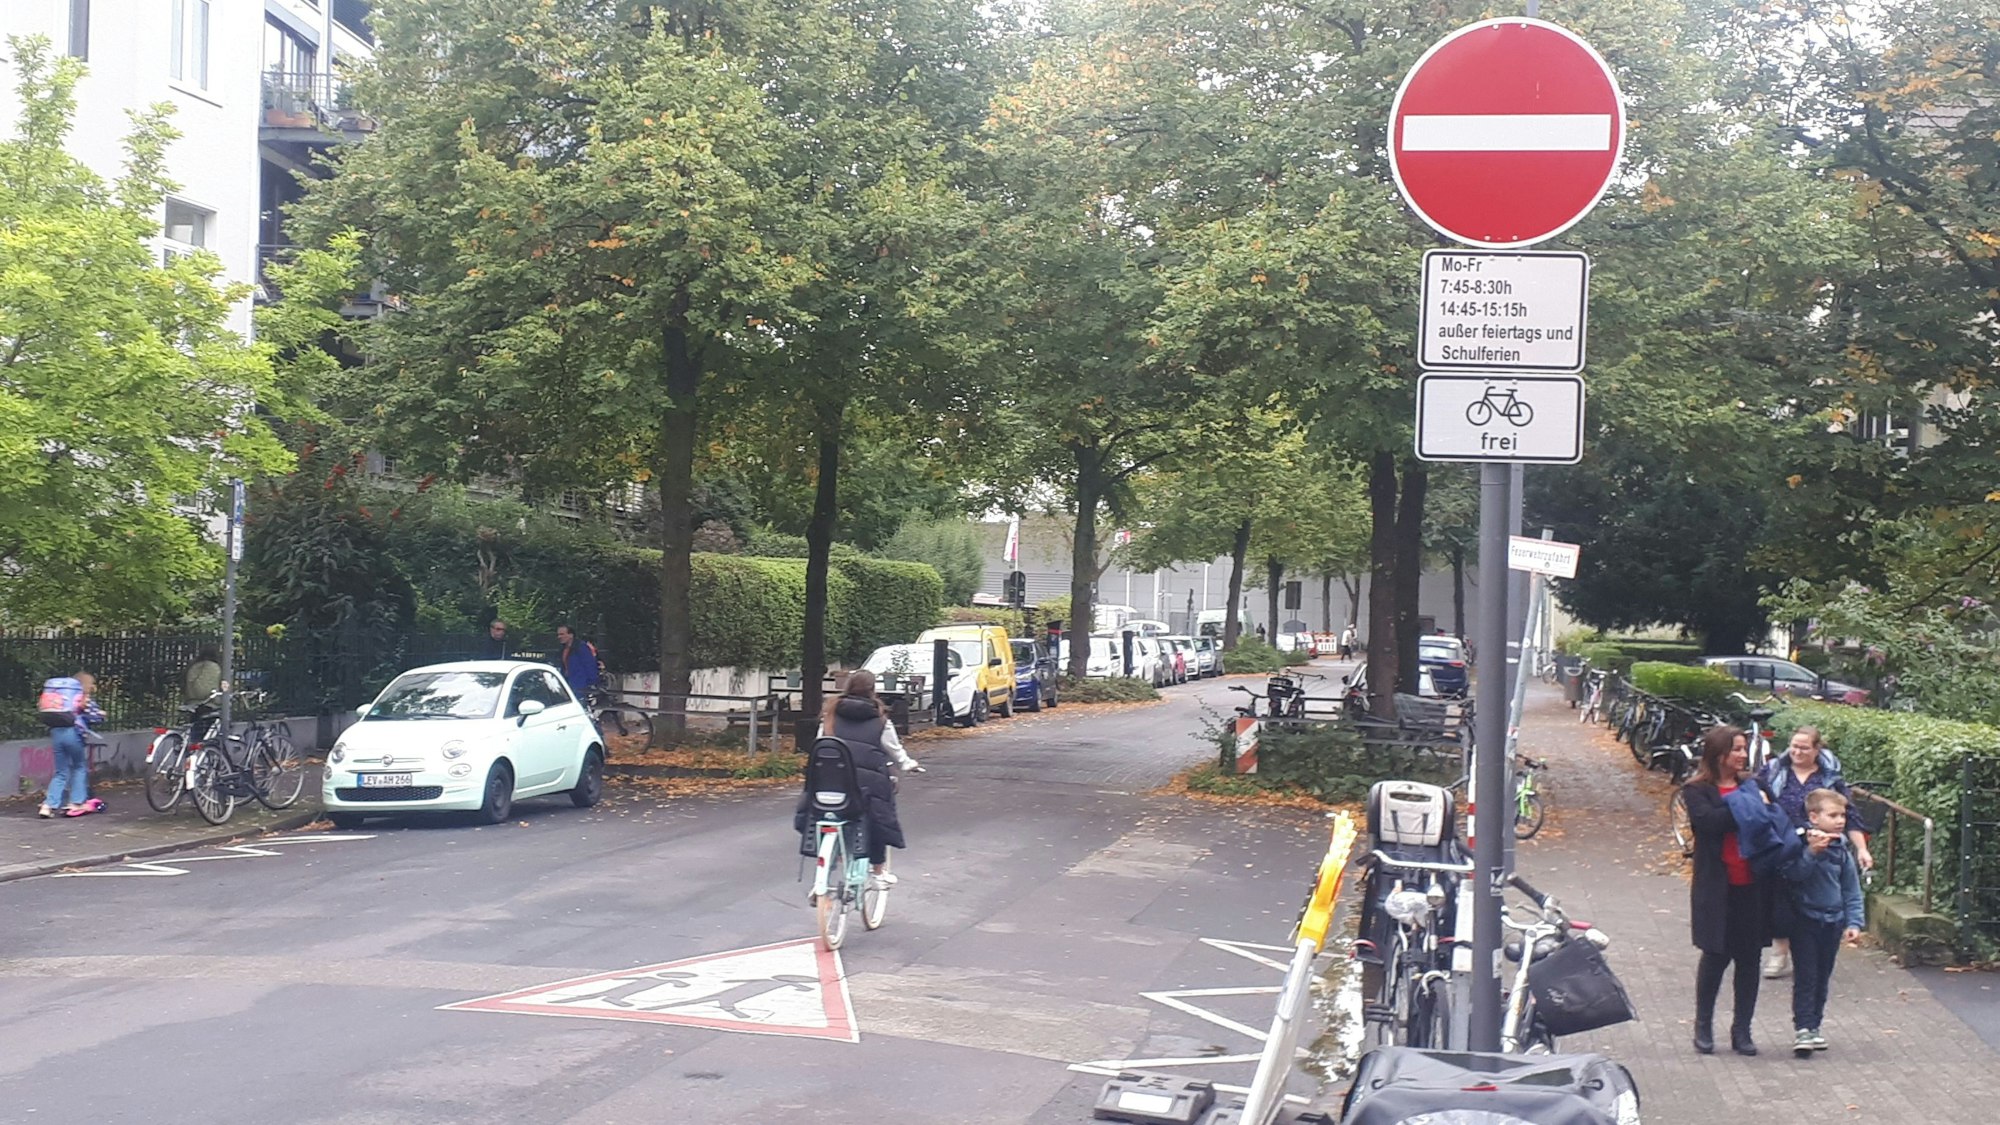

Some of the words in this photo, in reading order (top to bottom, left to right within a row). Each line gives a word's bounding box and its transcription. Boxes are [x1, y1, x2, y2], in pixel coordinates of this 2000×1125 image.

[1441, 257, 1482, 272] Mo-Fr
[1441, 279, 1512, 294] 7:45-8:30h
[1440, 301, 1527, 317] 14:45-15:15h
[1438, 323, 1478, 338] außer
[1482, 324, 1542, 343] feiertags
[1546, 325, 1573, 340] und
[1441, 345, 1520, 361] Schulferien
[1481, 432, 1517, 450] frei
